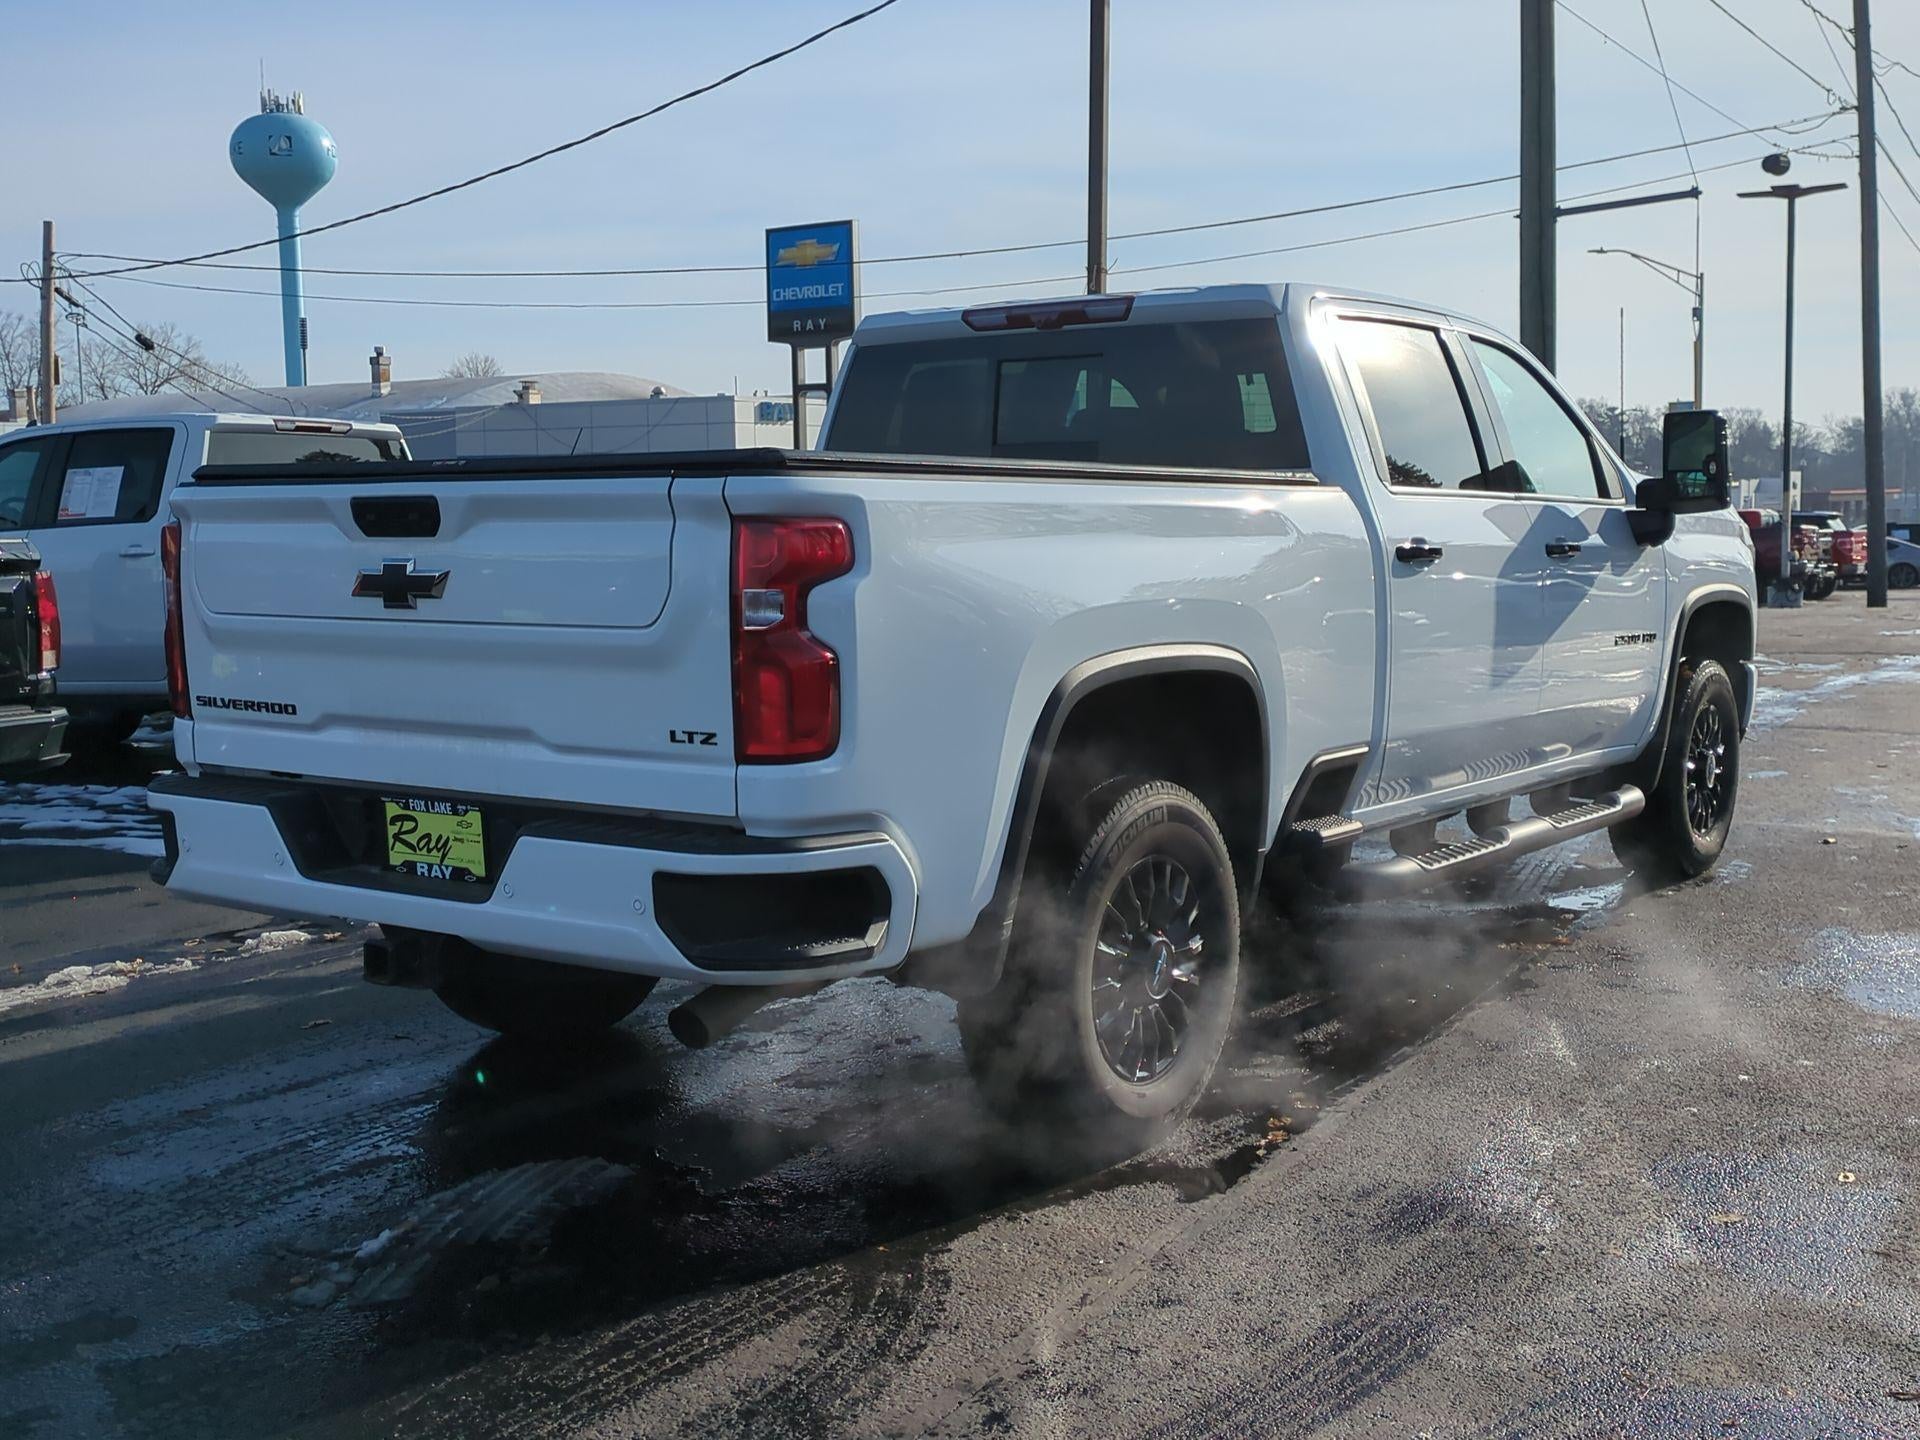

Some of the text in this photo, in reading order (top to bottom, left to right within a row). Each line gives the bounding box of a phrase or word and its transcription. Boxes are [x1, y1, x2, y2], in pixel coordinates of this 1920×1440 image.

[772, 283, 844, 302] CHEVROLET
[793, 318, 827, 332] RAY
[18, 686, 31, 694] LT
[196, 695, 298, 716] SILVERADO
[669, 729, 718, 746] LTZ
[408, 798, 427, 812] FOX
[428, 800, 453, 815] LAKE
[389, 813, 452, 866] Ray
[1107, 806, 1164, 863] MICHELIN
[416, 862, 453, 880] RAY
